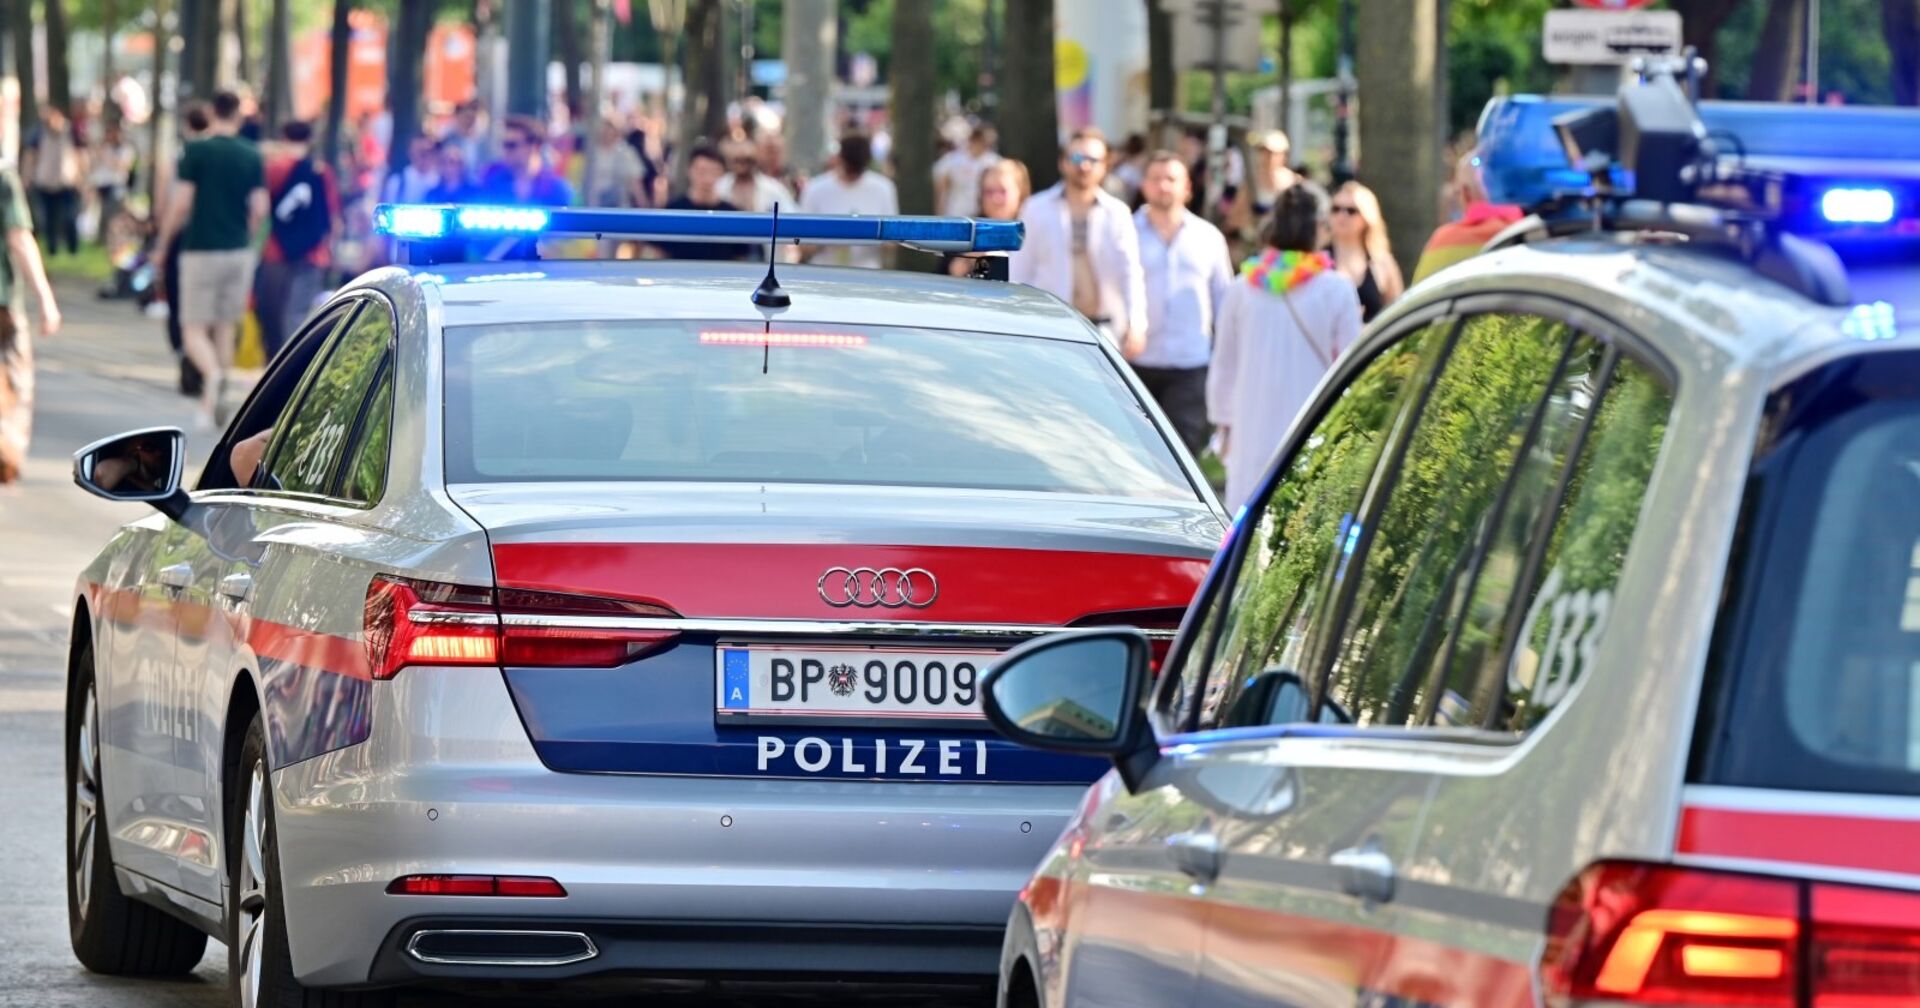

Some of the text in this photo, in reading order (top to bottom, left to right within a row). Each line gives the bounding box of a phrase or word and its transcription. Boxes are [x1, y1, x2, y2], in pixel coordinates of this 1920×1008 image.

[305, 424, 345, 485] 133
[731, 687, 743, 701] A
[771, 658, 977, 706] BP 9009
[757, 736, 987, 775] POLIZEI
